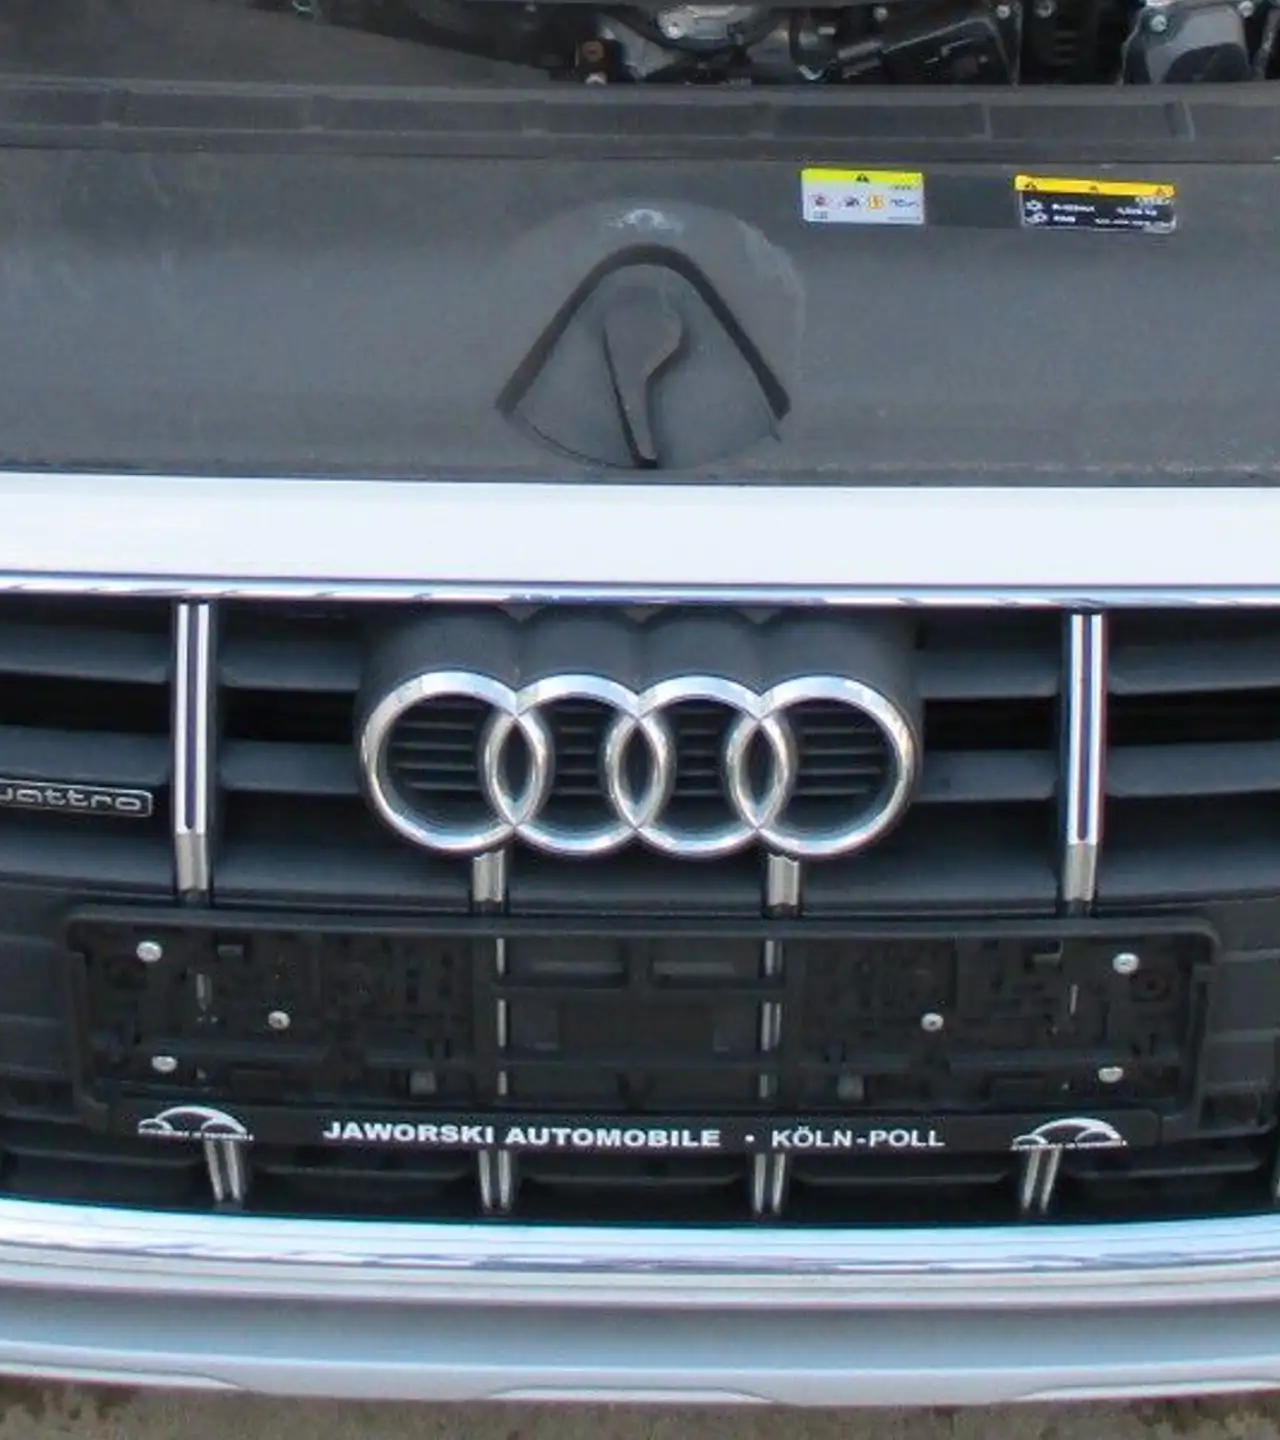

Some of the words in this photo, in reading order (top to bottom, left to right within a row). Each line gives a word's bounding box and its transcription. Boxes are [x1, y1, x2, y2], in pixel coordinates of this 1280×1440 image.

[323, 1122, 493, 1144] JAWORSKI
[505, 1126, 721, 1148] AUTOMOBILE
[771, 1125, 945, 1148] KÖLN-POLL
